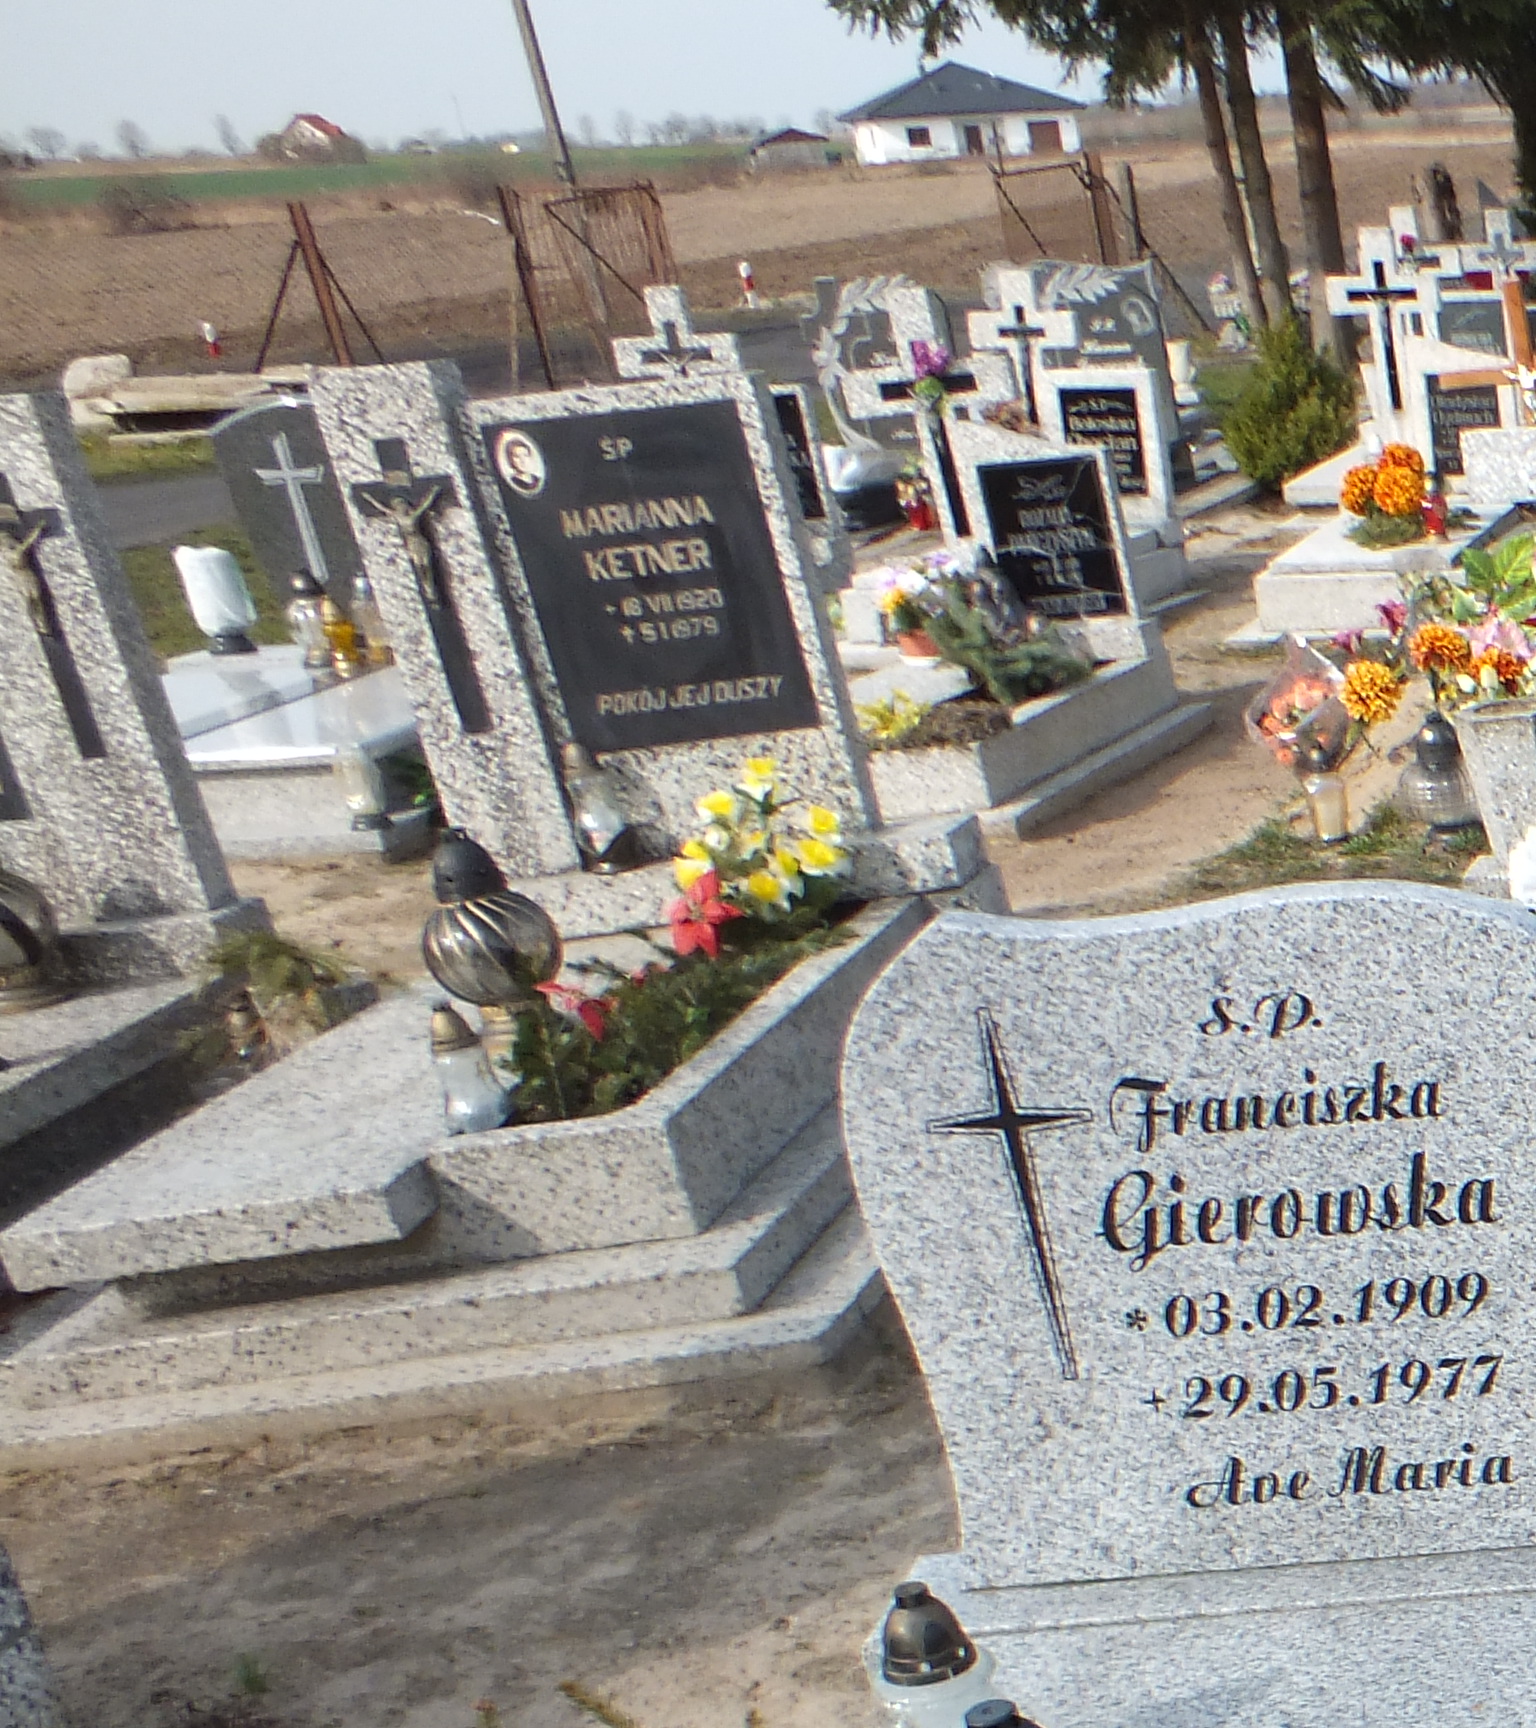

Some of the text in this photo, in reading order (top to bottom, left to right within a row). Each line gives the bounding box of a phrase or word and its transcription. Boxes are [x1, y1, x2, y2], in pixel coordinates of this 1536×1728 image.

[559, 495, 716, 540] MARIANNA
[583, 537, 713, 583] KETNER
[669, 682, 710, 710] JEJ
[711, 674, 785, 704] DUSZY
[1108, 1060, 1444, 1154] Franciszka
[1095, 1150, 1504, 1273] Gierowska
[1165, 1271, 1490, 1338] 03.02.1909
[1182, 1354, 1503, 1418] 29.05.1977
[1186, 1441, 1516, 1509] Ave Maria
